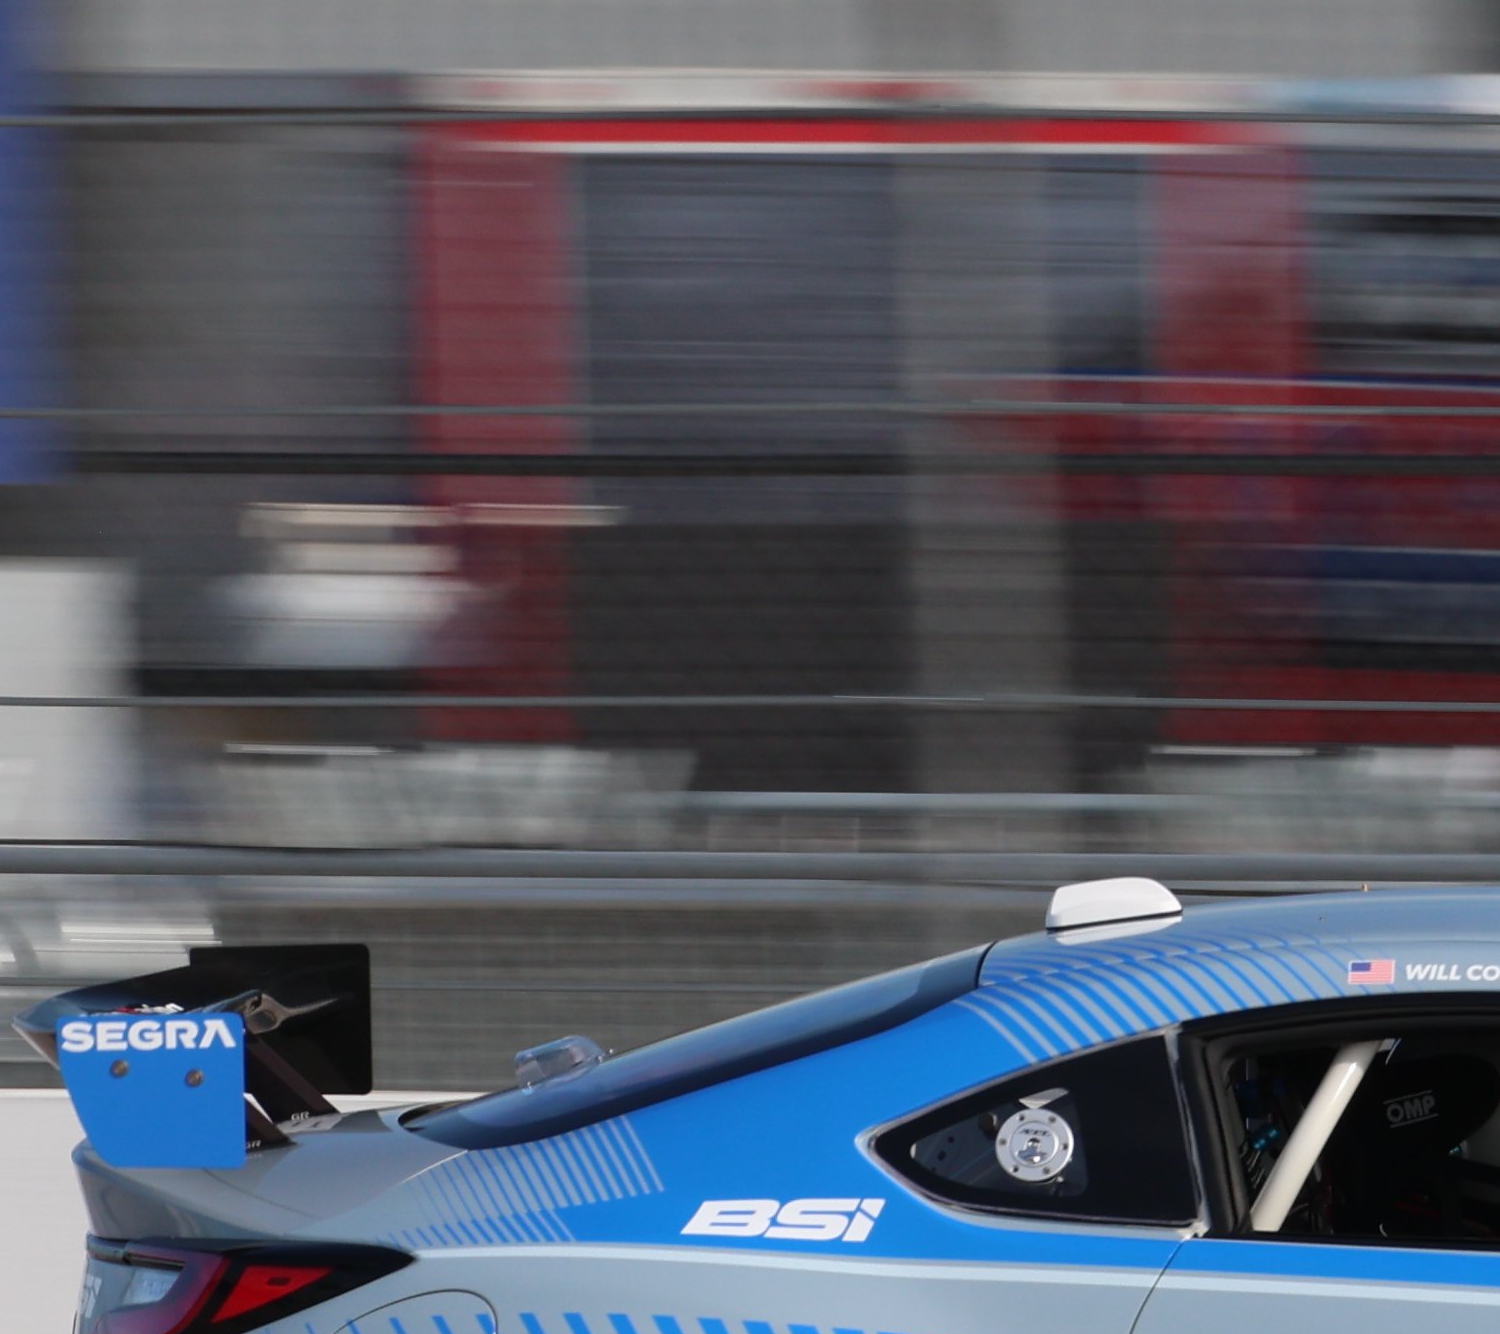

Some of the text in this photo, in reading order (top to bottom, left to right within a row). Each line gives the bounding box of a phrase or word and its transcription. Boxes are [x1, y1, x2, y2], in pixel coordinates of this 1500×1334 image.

[1406, 963, 1462, 981] WILL
[60, 1019, 237, 1053] SEGRA
[1385, 1094, 1436, 1124] OMP
